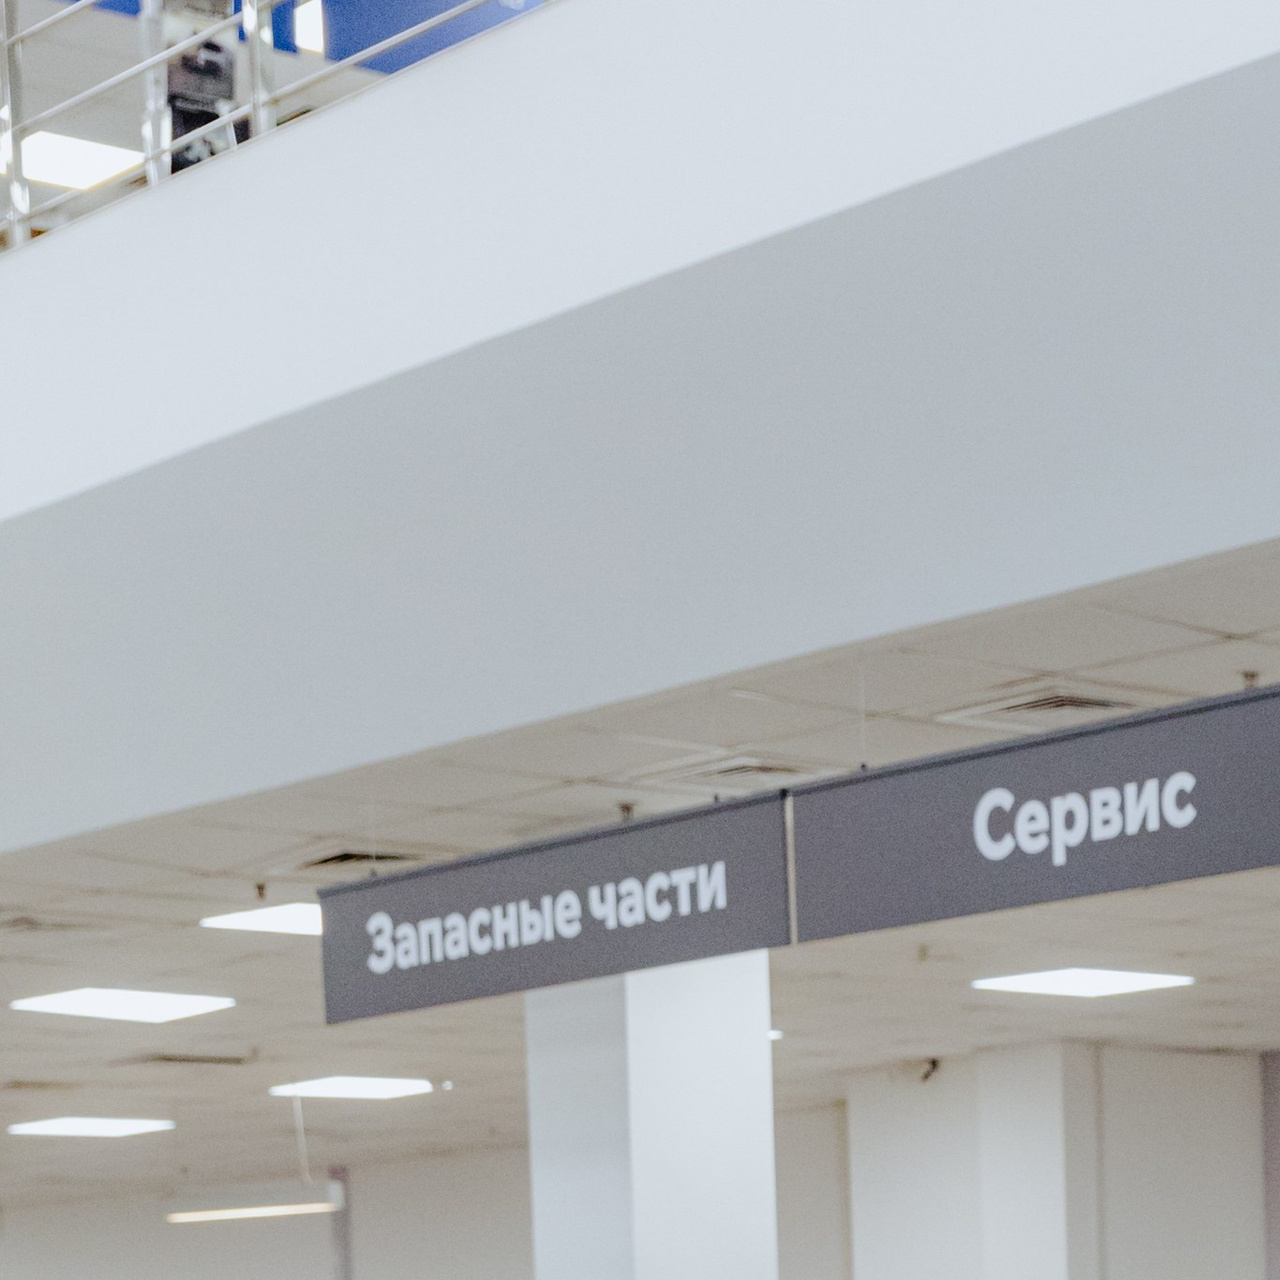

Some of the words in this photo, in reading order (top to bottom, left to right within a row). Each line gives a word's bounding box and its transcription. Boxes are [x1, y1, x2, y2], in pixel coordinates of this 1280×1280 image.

[972, 770, 1198, 865] Сервис
[366, 886, 582, 975] Запасные
[587, 859, 728, 933] части
